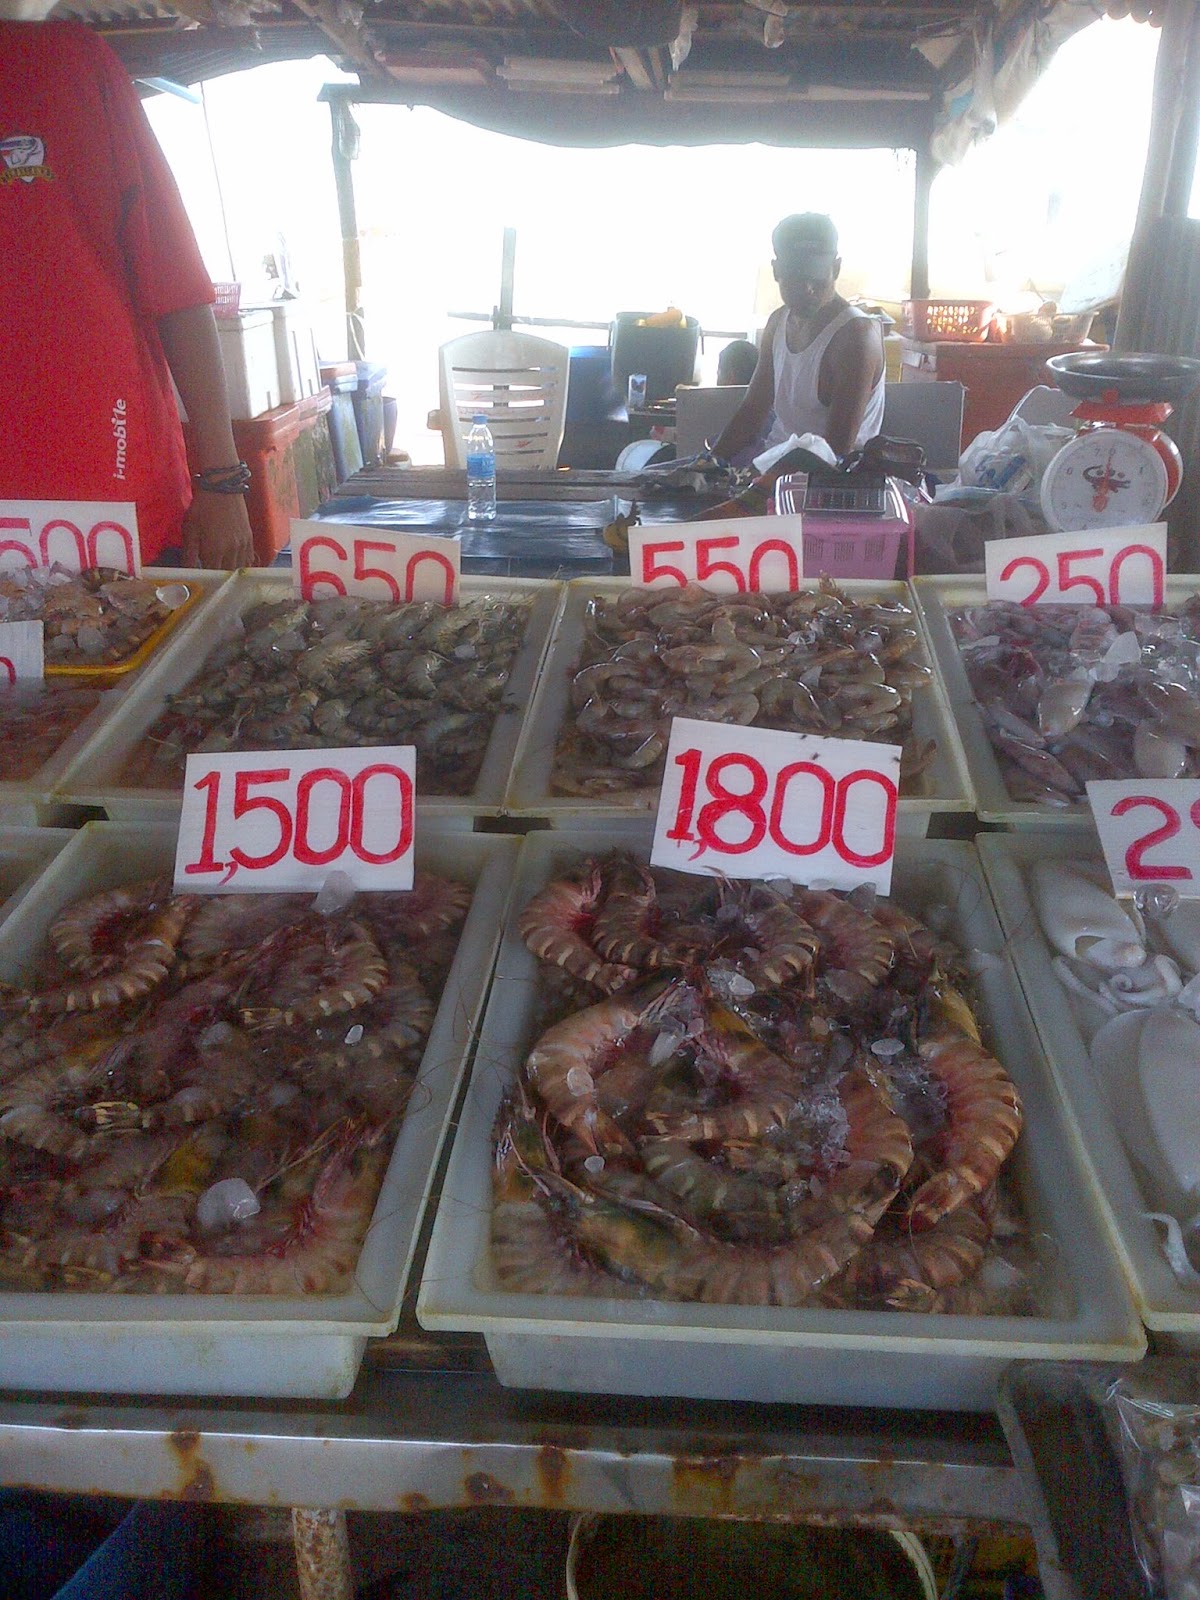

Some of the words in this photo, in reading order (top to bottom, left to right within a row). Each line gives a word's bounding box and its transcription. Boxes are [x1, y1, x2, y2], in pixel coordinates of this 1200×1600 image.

[111, 398, 127, 480] i-mobile
[299, 536, 455, 608] 650
[642, 536, 800, 593] 550
[1000, 544, 1164, 614] 250
